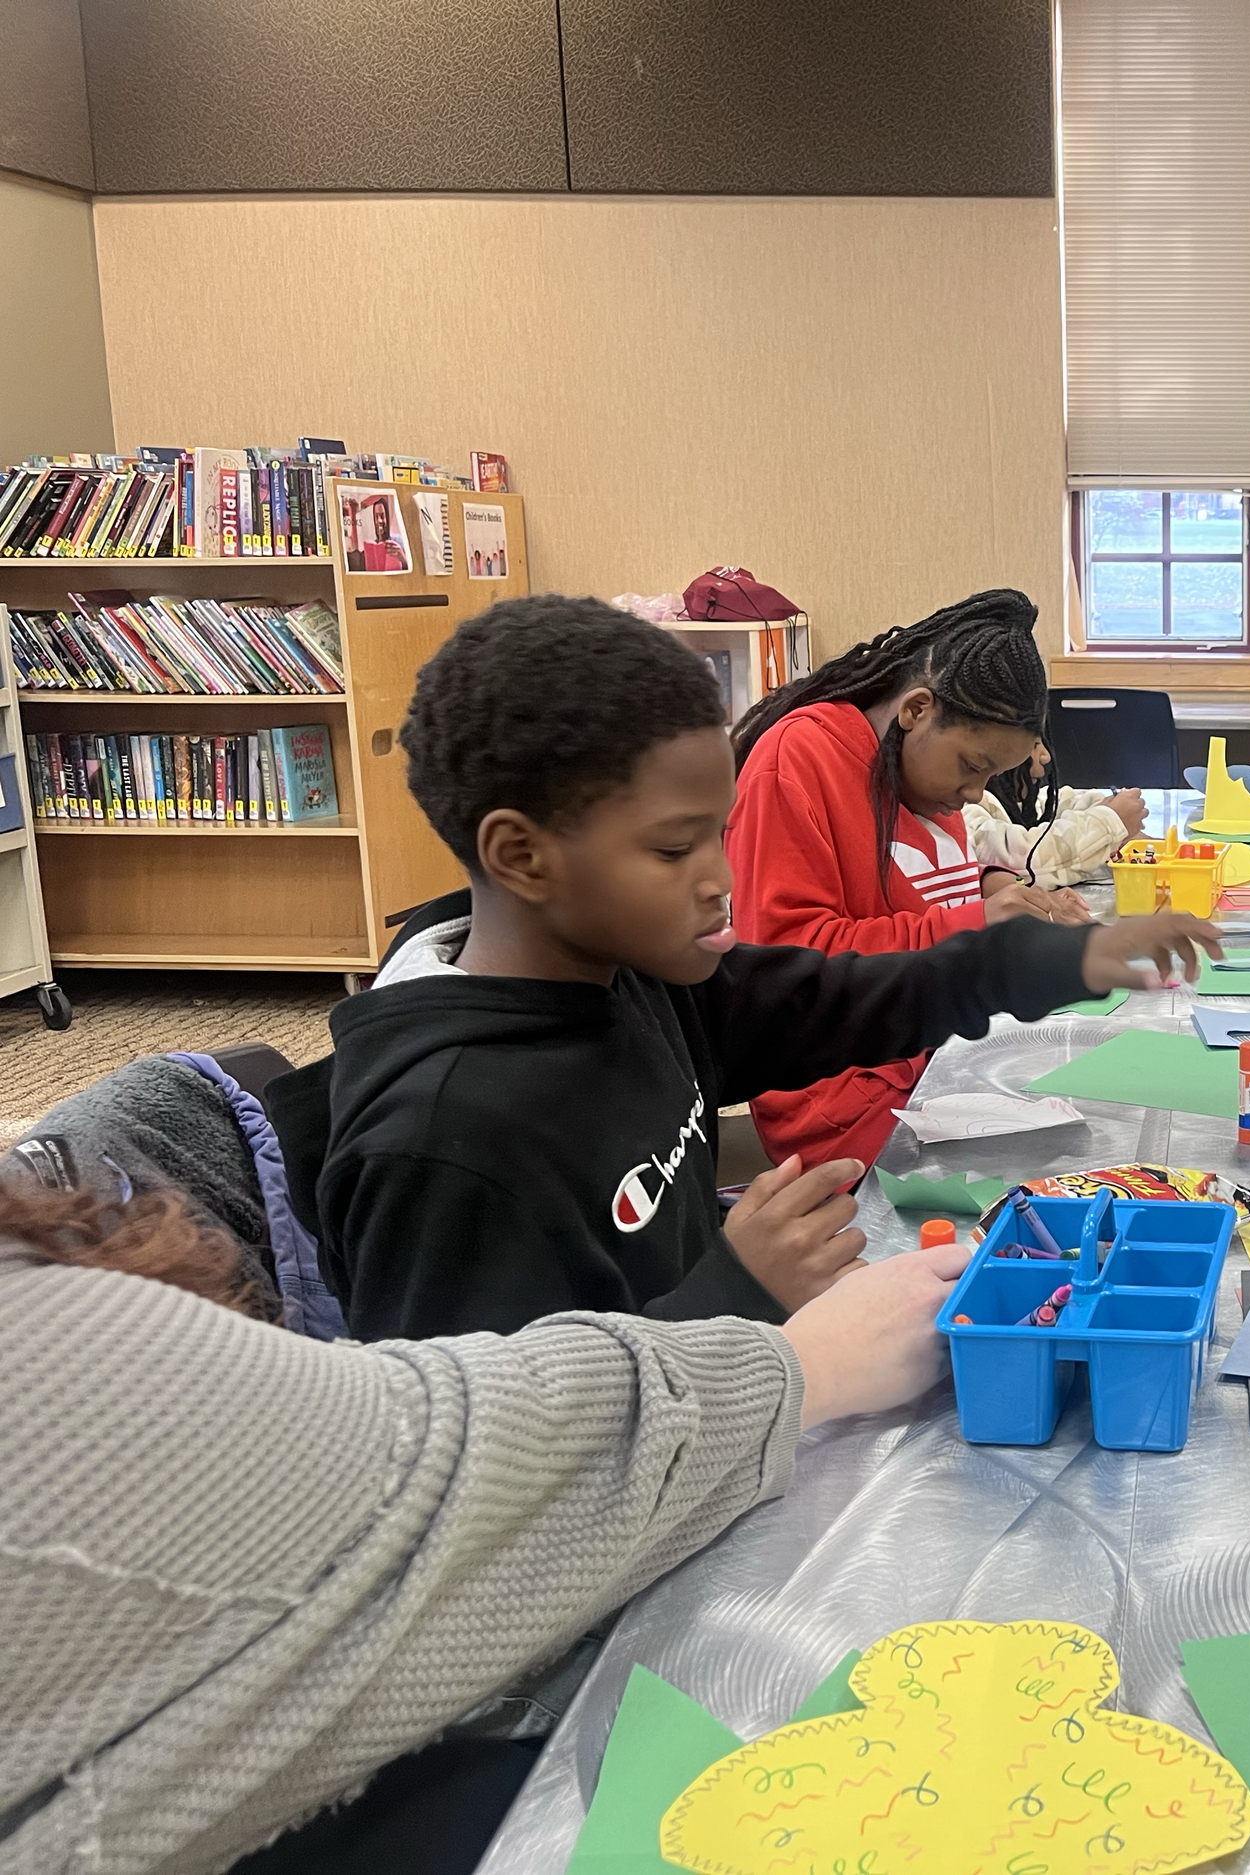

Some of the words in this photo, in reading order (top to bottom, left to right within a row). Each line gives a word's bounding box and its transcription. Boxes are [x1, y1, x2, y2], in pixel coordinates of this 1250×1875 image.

[222, 475, 238, 549] REPLIC
[121, 755, 129, 767] THE
[122, 768, 131, 784] LAST
[124, 785, 132, 798] LAU
